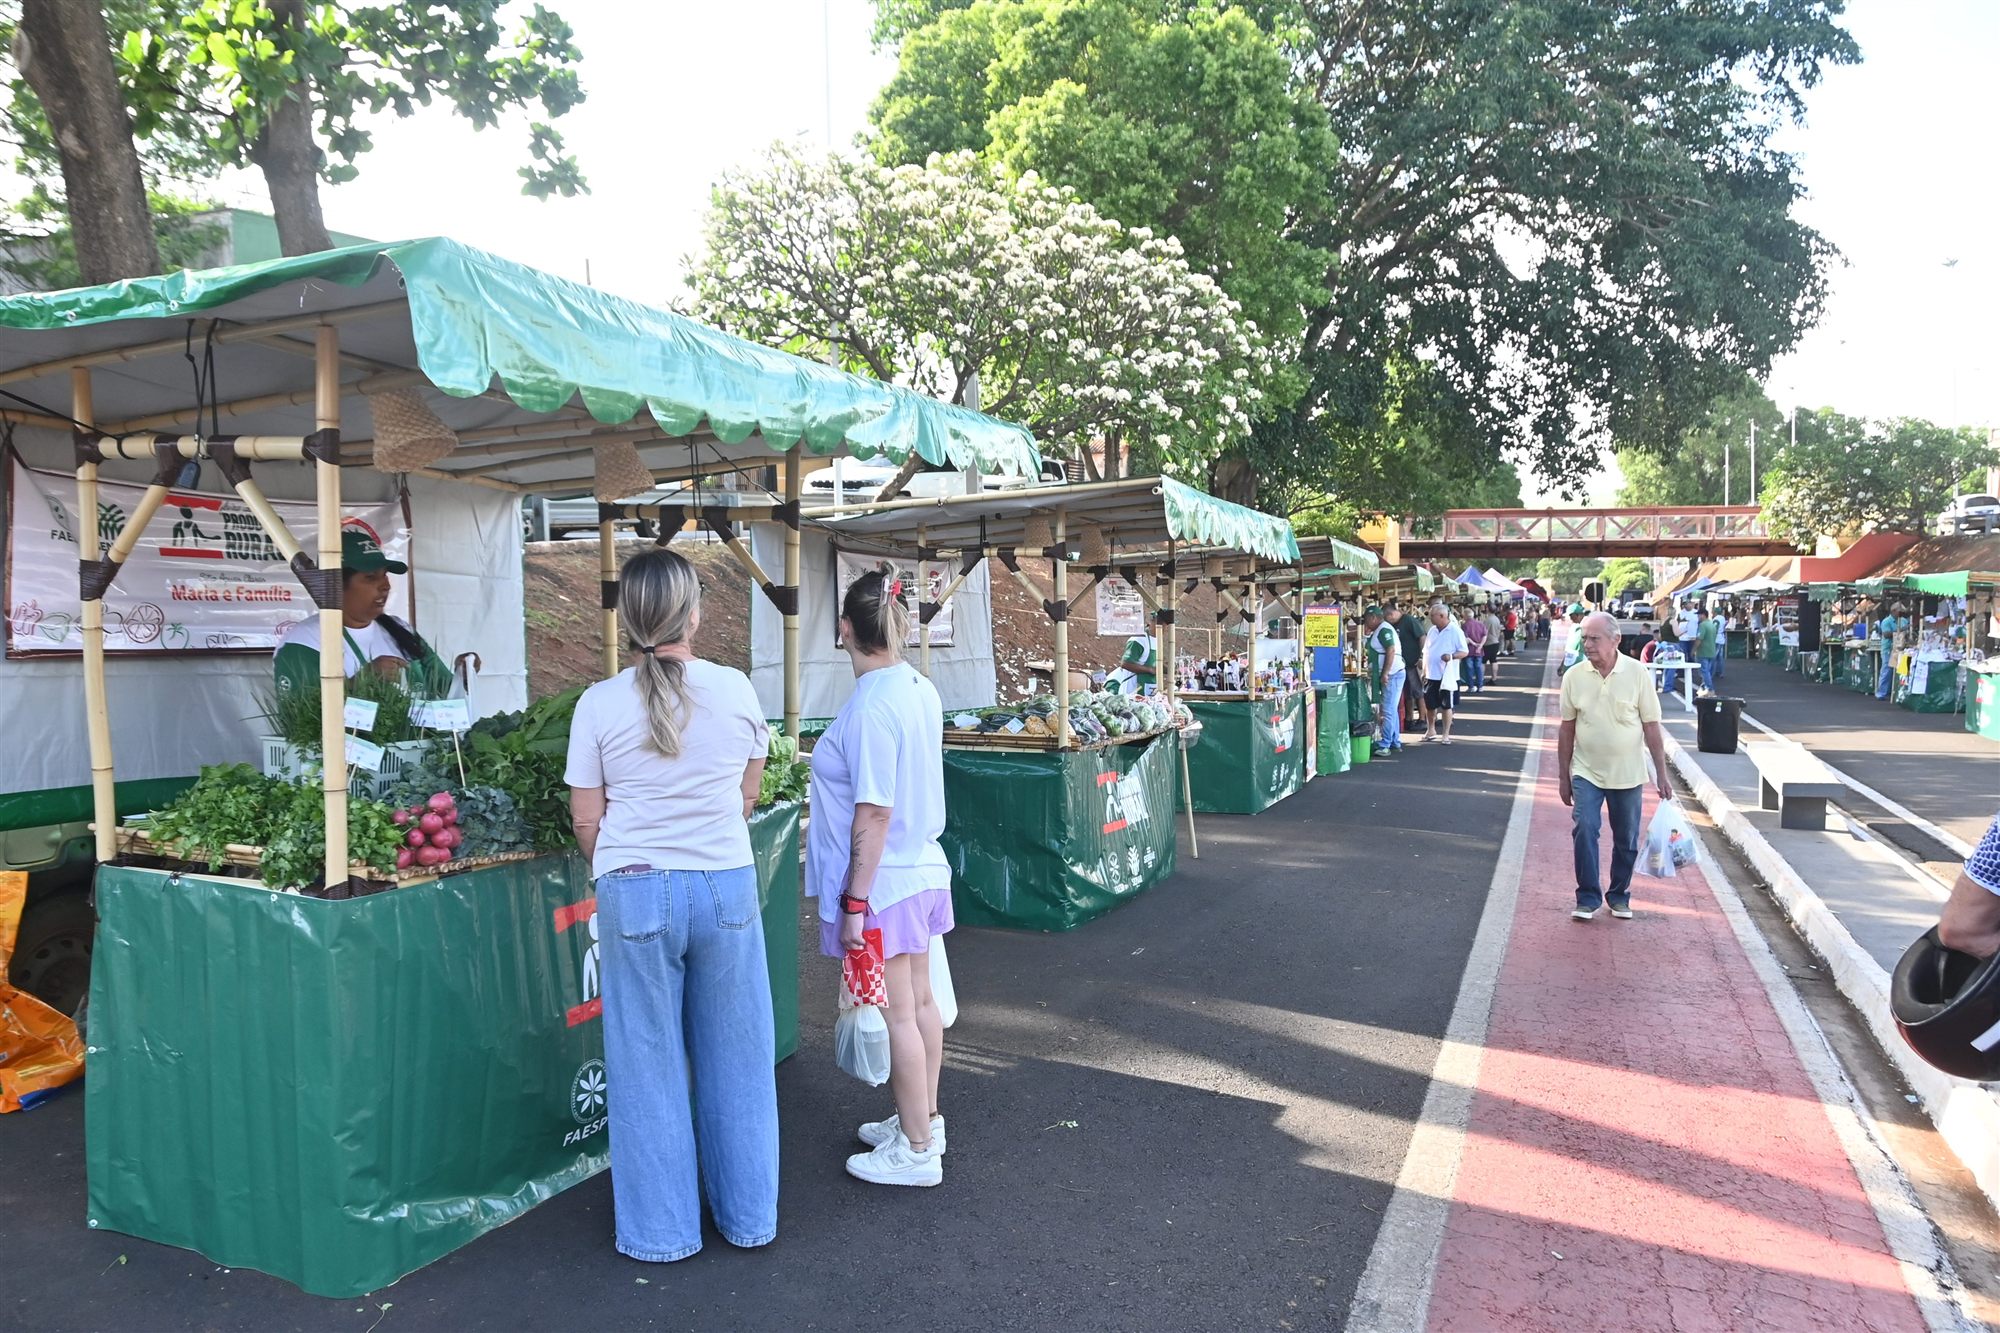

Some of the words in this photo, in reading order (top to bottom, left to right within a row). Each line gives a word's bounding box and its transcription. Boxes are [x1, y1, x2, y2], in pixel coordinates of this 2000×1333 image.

[172, 584, 219, 601] Maria
[223, 589, 232, 601] e
[236, 585, 292, 601] Família
[563, 1116, 608, 1147] FAESP
